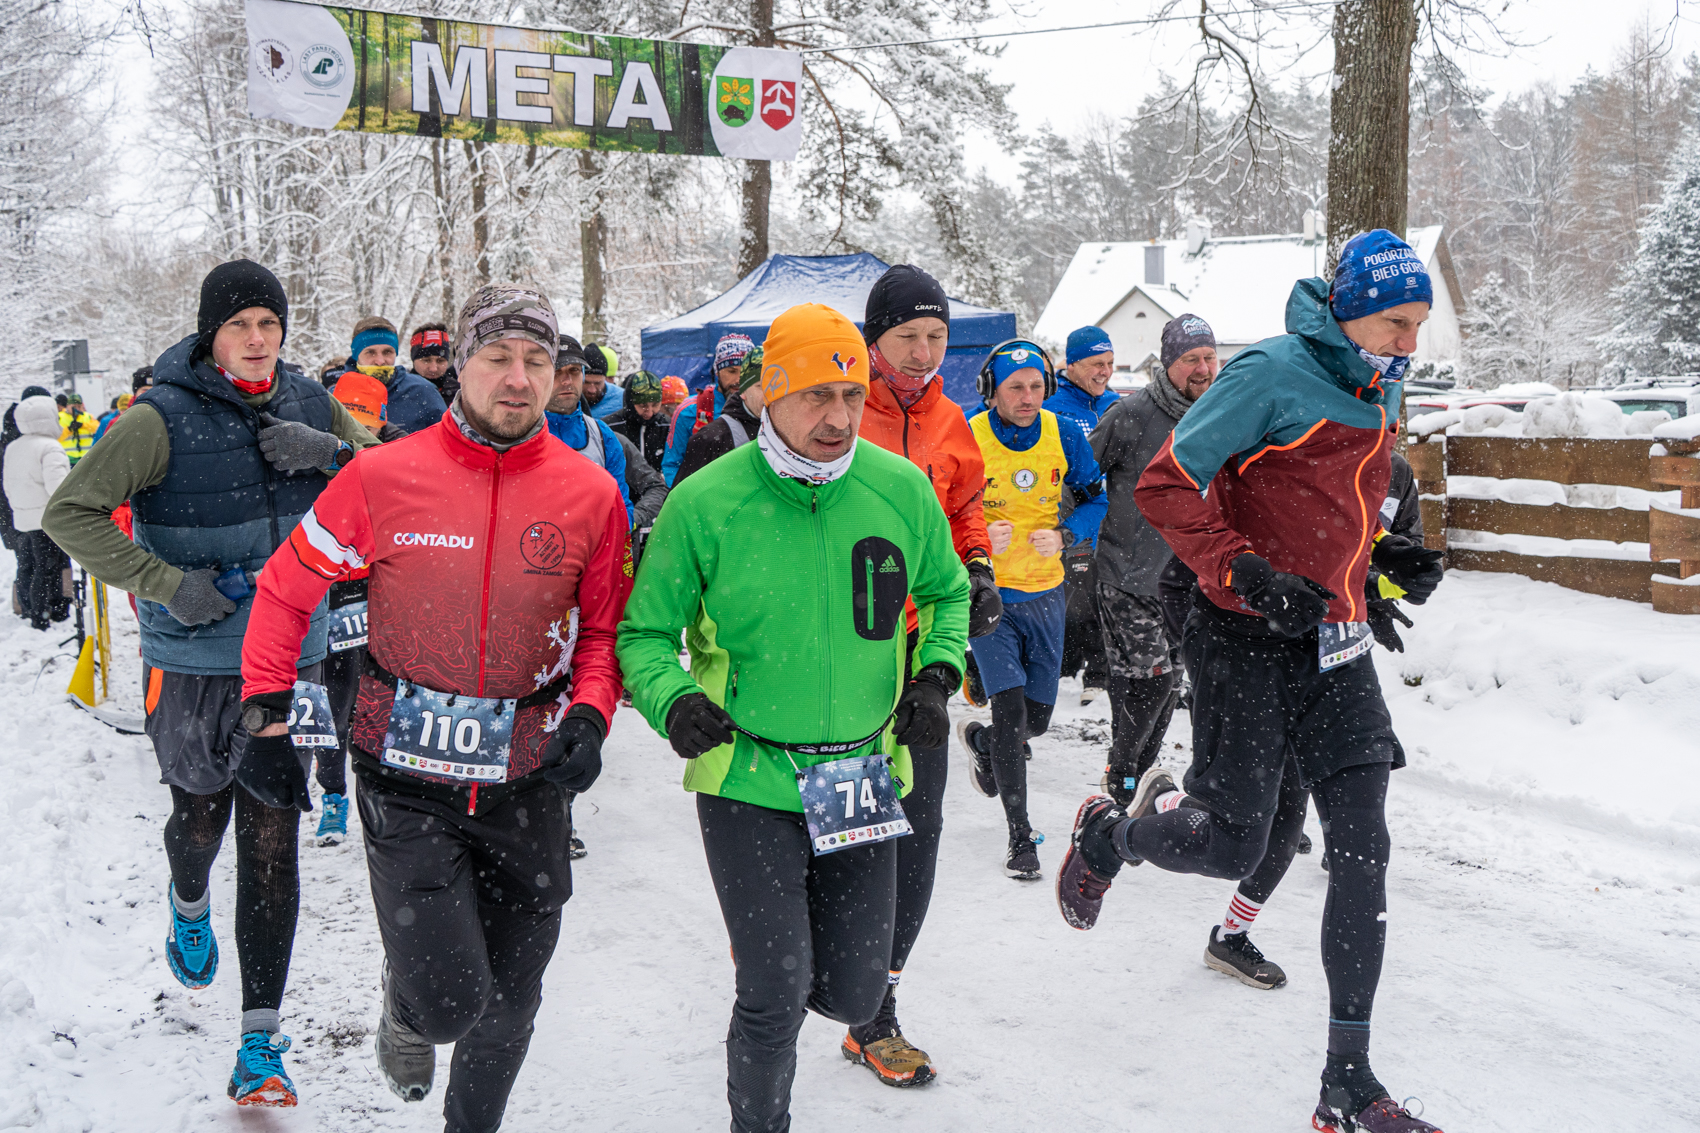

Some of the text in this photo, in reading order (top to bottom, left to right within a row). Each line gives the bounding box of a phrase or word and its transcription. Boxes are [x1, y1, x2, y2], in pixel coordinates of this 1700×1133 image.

[410, 40, 673, 132] META
[1371, 264, 1400, 283] BIEG
[393, 532, 475, 550] CONTADU
[419, 710, 481, 754] 110
[834, 777, 878, 819] 74
